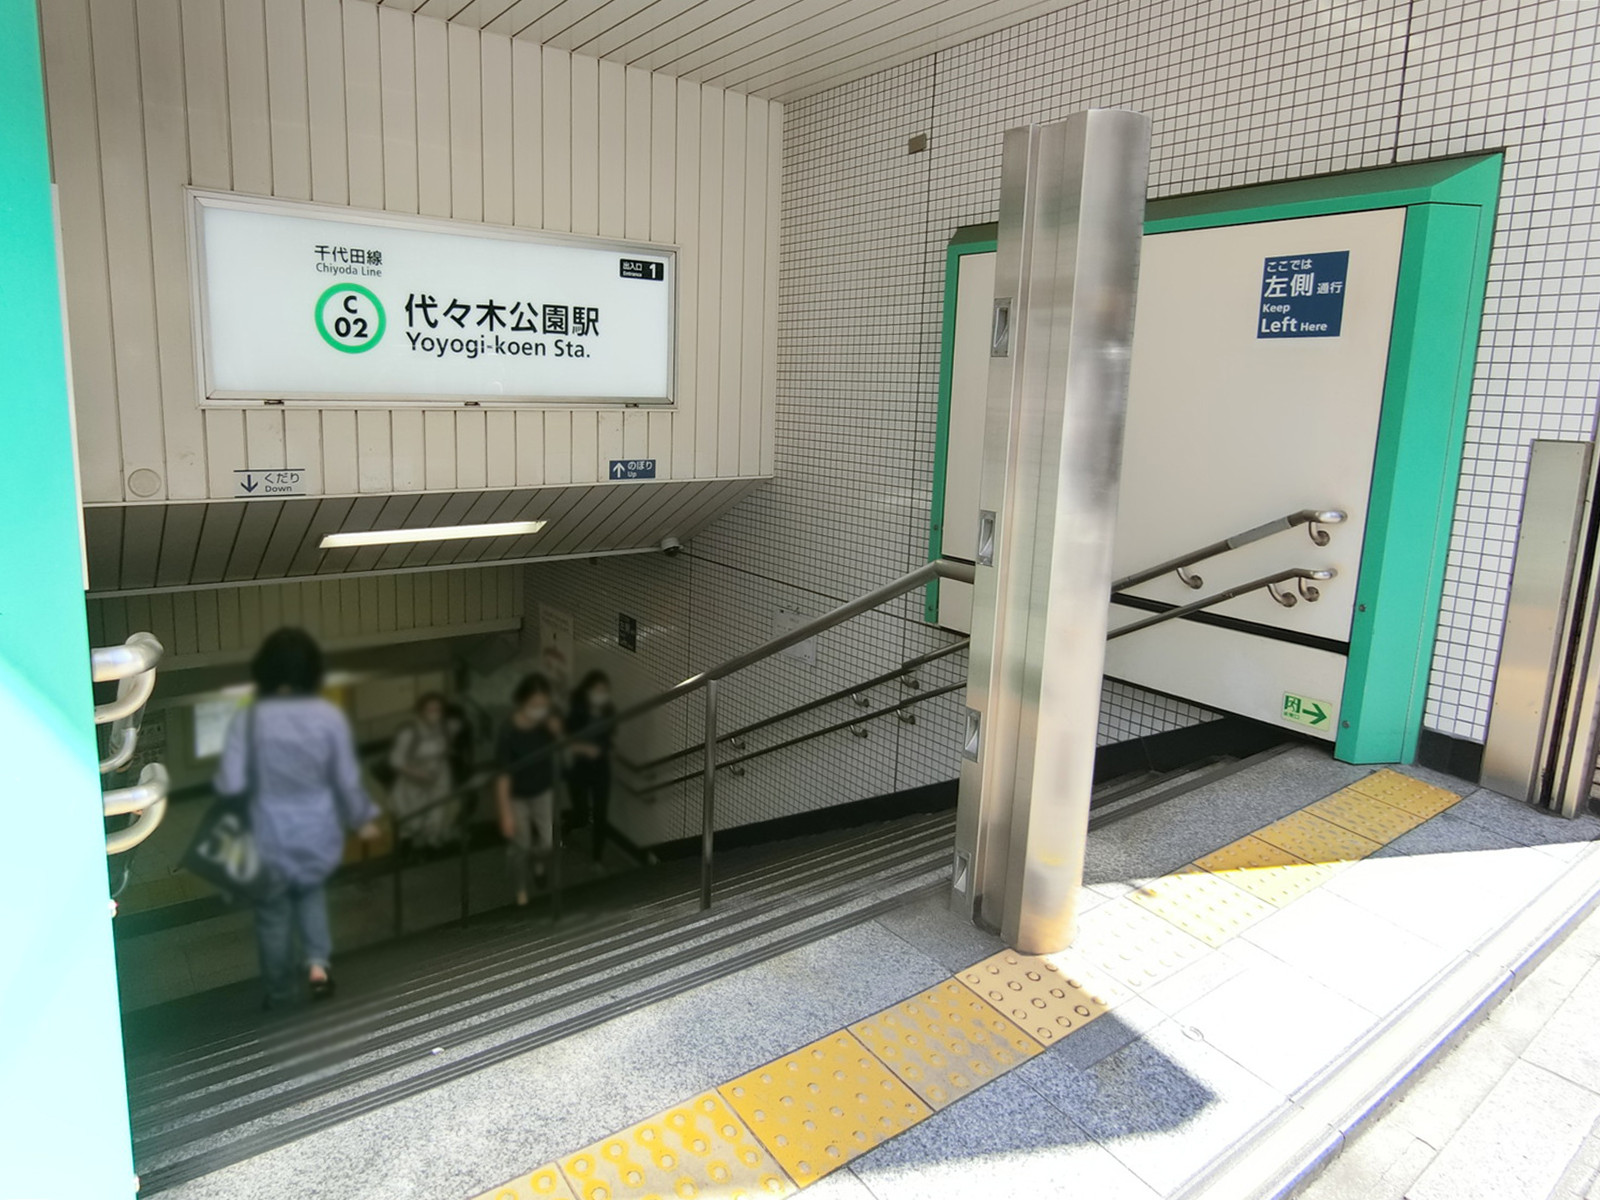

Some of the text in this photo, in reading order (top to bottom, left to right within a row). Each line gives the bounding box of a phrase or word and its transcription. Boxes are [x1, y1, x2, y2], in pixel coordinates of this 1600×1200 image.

[314, 245, 383, 267] 千代田線
[315, 262, 382, 277] Chiyoda Line
[622, 261, 657, 279] 出入口 1
[1266, 259, 1313, 272] ここでは
[343, 295, 358, 314] C
[1262, 303, 1291, 314] Keep
[404, 293, 600, 337] 代々木公園駅
[334, 316, 369, 338] 02
[1261, 316, 1328, 333] Left Here
[405, 331, 591, 359] Yoyogi-koen Sta.
[627, 461, 653, 471] のぼり
[264, 472, 300, 484] くだり
[264, 485, 293, 493] Down
